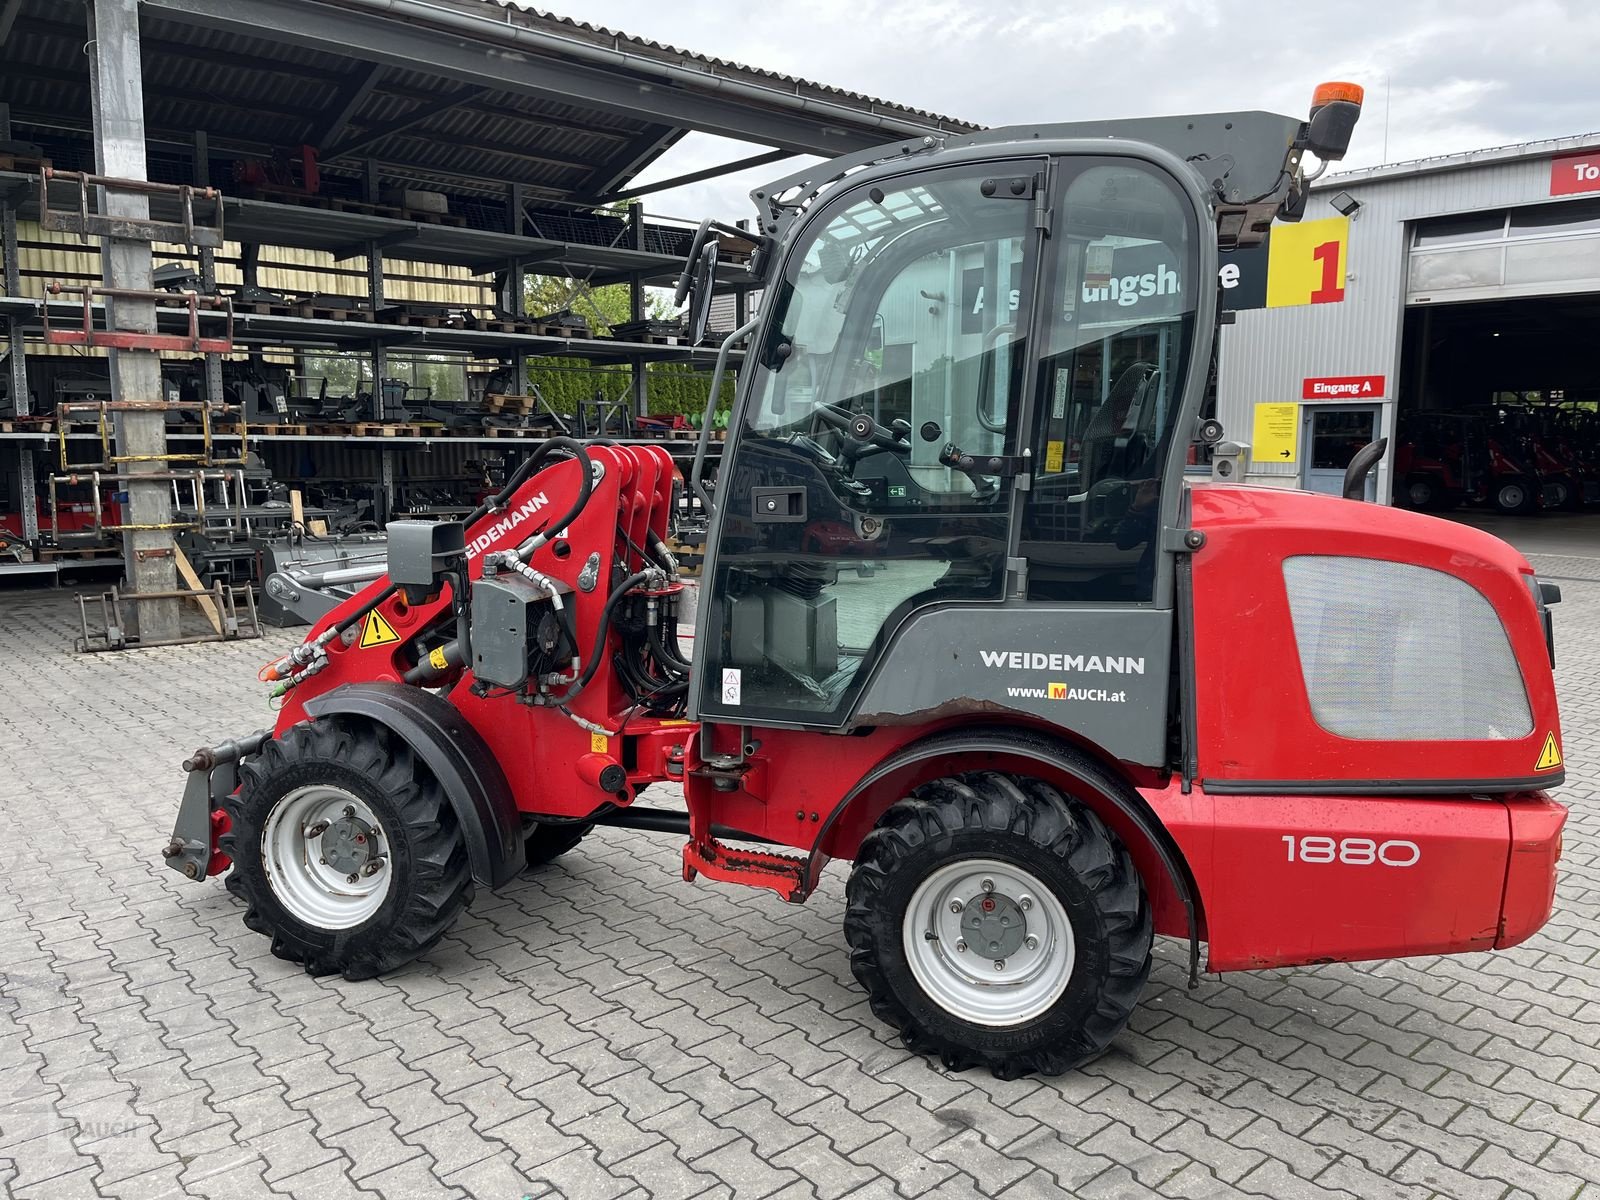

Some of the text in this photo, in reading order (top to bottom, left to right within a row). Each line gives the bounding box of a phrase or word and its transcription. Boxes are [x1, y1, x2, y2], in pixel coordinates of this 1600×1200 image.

[1311, 241, 1345, 304] 1
[1313, 381, 1372, 395] Eingang A
[464, 491, 550, 560] EIDEMANN
[979, 650, 1146, 675] WEIDEMANN
[1007, 683, 1126, 703] www.MAUCH.at
[1281, 835, 1421, 867] 1880
